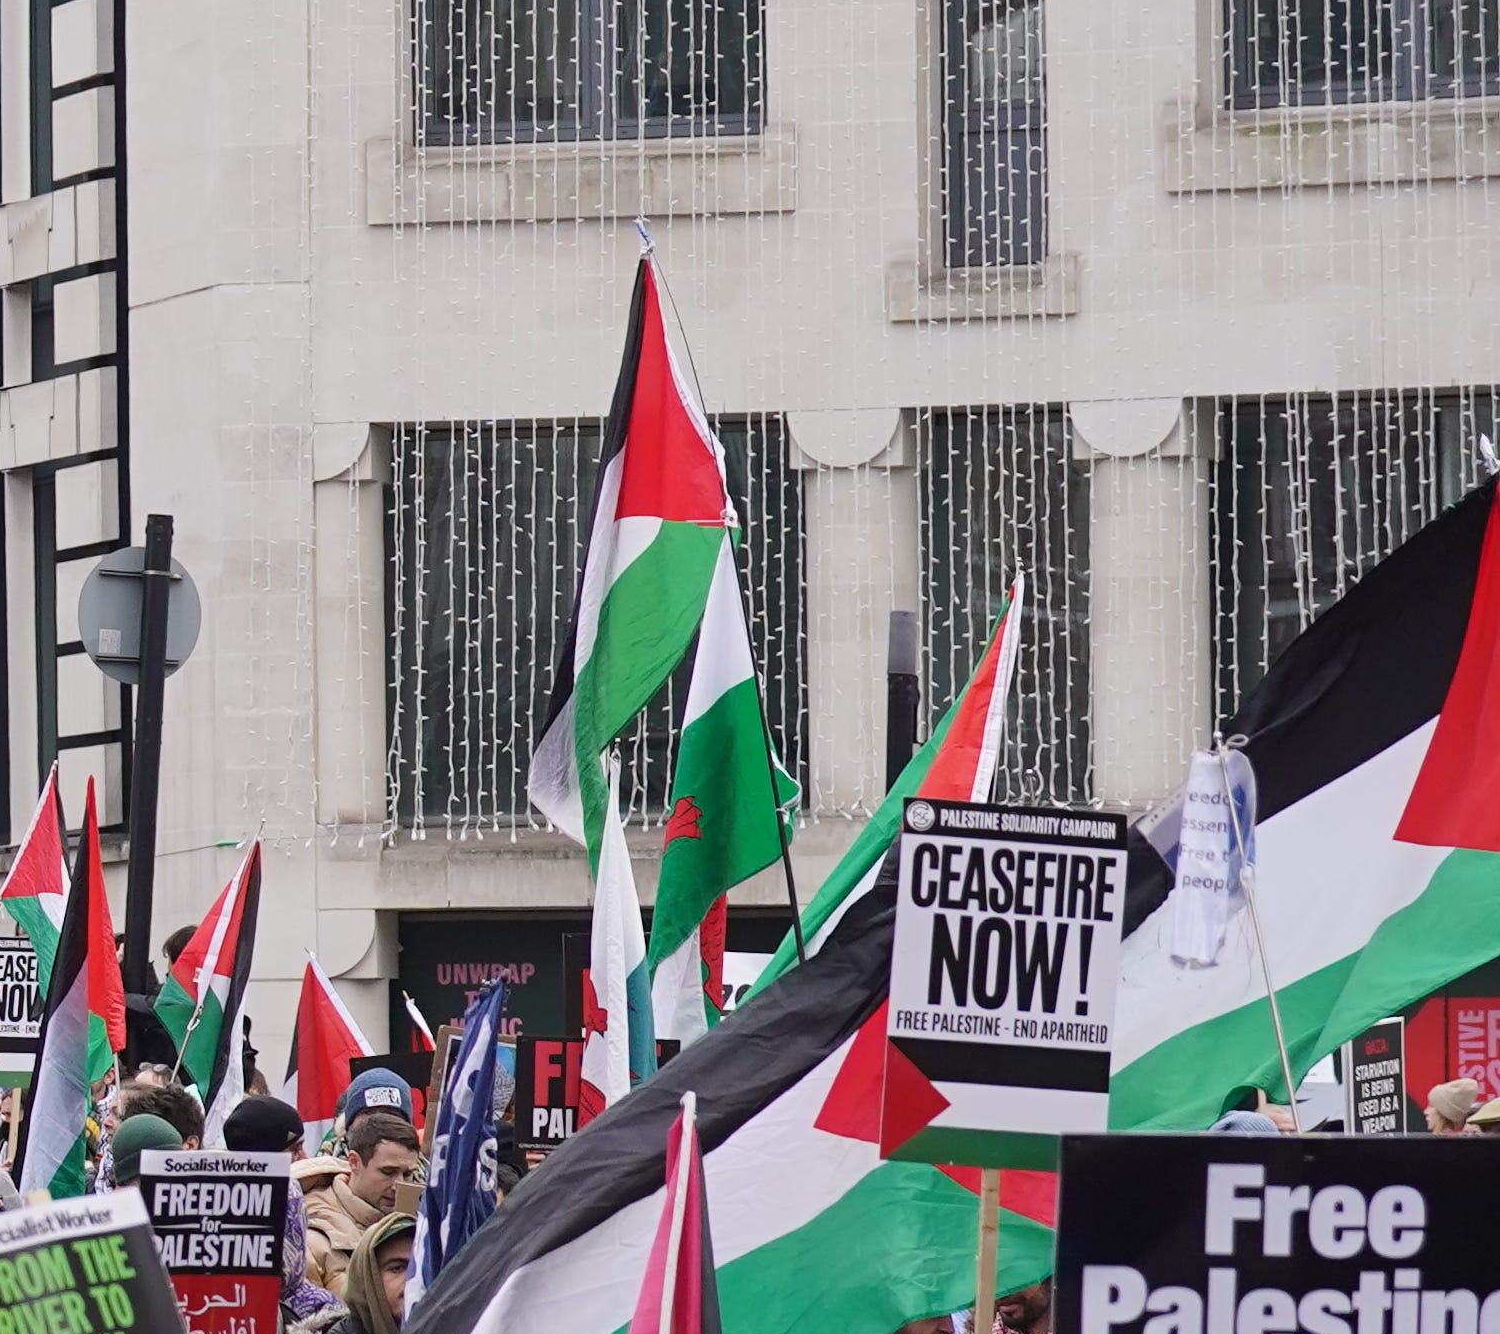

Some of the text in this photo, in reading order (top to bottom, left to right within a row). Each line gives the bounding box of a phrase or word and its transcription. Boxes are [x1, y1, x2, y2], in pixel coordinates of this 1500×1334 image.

[940, 808, 1116, 840] PALESTINE SOLIDARITY CAMPAIGN
[911, 842, 1117, 922] CEASEFIRE
[438, 964, 535, 985] UNWRAP
[928, 913, 1095, 1016] NOW!
[896, 1010, 1108, 1044] FREE PALESTINE END APARTHEID
[1355, 1058, 1400, 1080] STARVATION
[1361, 1078, 1394, 1098] IS BEING
[1358, 1098, 1392, 1116] USED AS
[1362, 1114, 1396, 1134] WEAPON
[165, 1158, 268, 1173] Socialist Worker
[153, 1182, 272, 1218] FREEDOM
[1205, 1163, 1426, 1259] Free
[54, 1204, 113, 1233] Worker
[201, 1216, 221, 1233] for
[71, 1234, 137, 1283] THE
[154, 1234, 274, 1268] PALESTINE
[89, 1283, 135, 1330] TO
